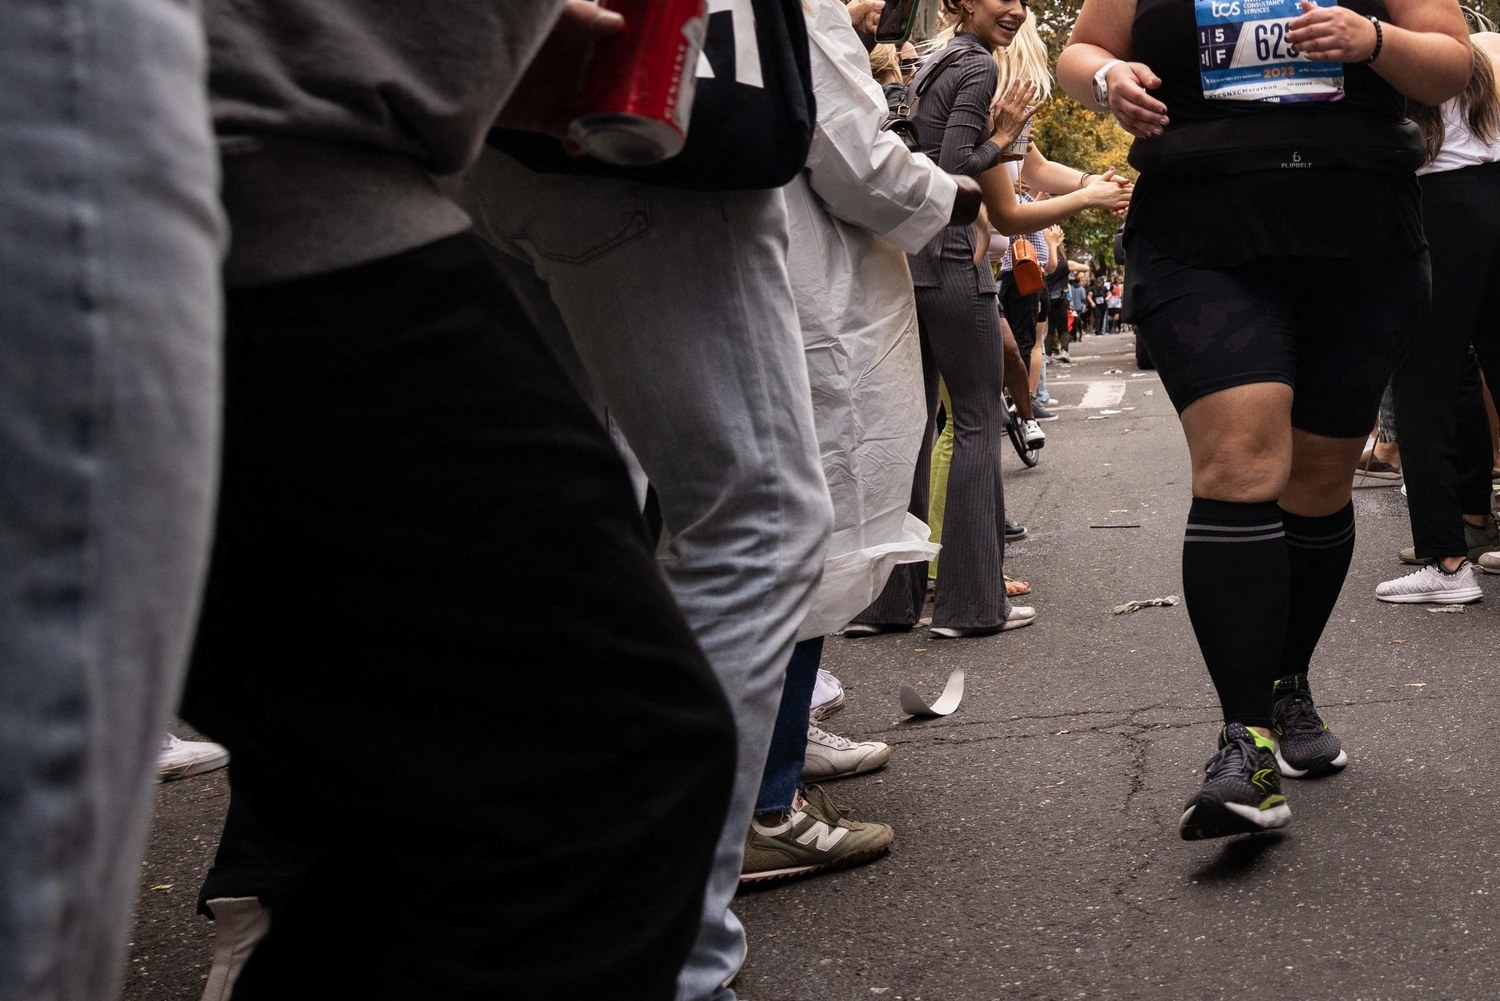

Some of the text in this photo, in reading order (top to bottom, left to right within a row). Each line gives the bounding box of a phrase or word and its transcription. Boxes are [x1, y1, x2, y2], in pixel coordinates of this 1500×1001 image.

[1211, 0, 1241, 18] tcs
[1243, 7, 1270, 15] SERVICES
[1215, 28, 1225, 43] 5
[1215, 49, 1227, 64] F
[1263, 66, 1295, 79] 2022
